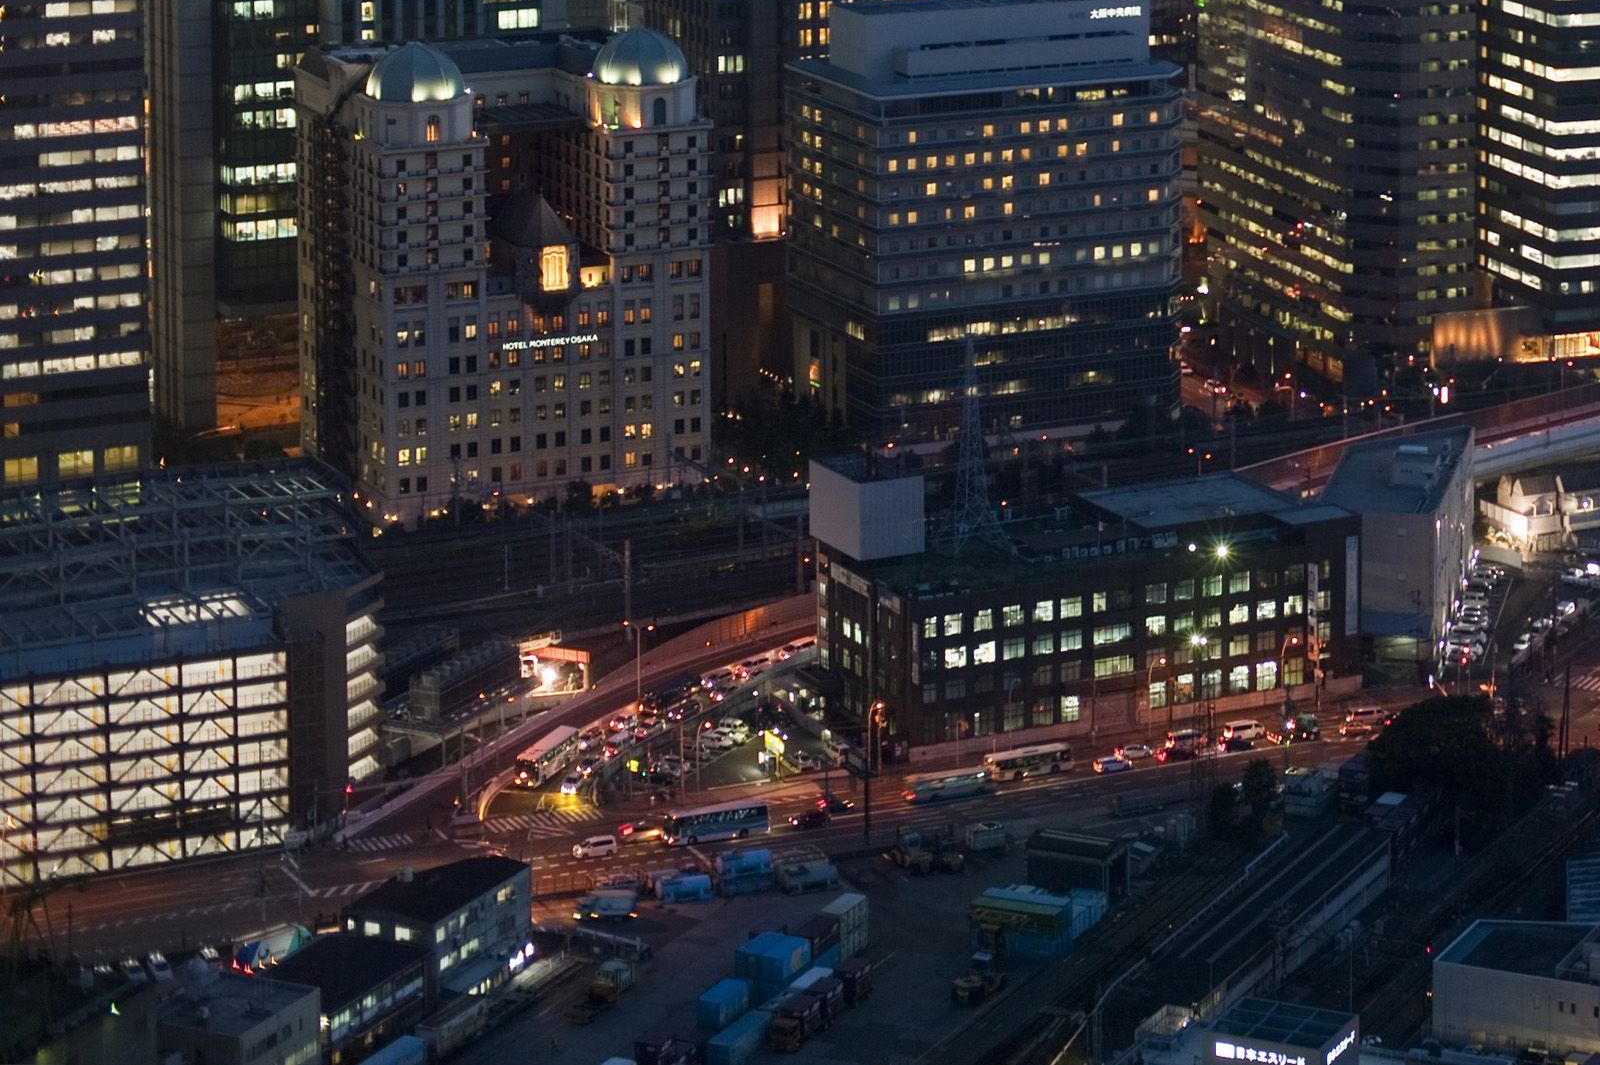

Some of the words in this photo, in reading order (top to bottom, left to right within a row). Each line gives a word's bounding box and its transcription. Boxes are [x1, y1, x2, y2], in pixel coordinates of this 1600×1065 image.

[502, 341, 528, 351] HOTEL
[529, 337, 571, 348] MONTEREY
[571, 334, 599, 344] OSAKA
